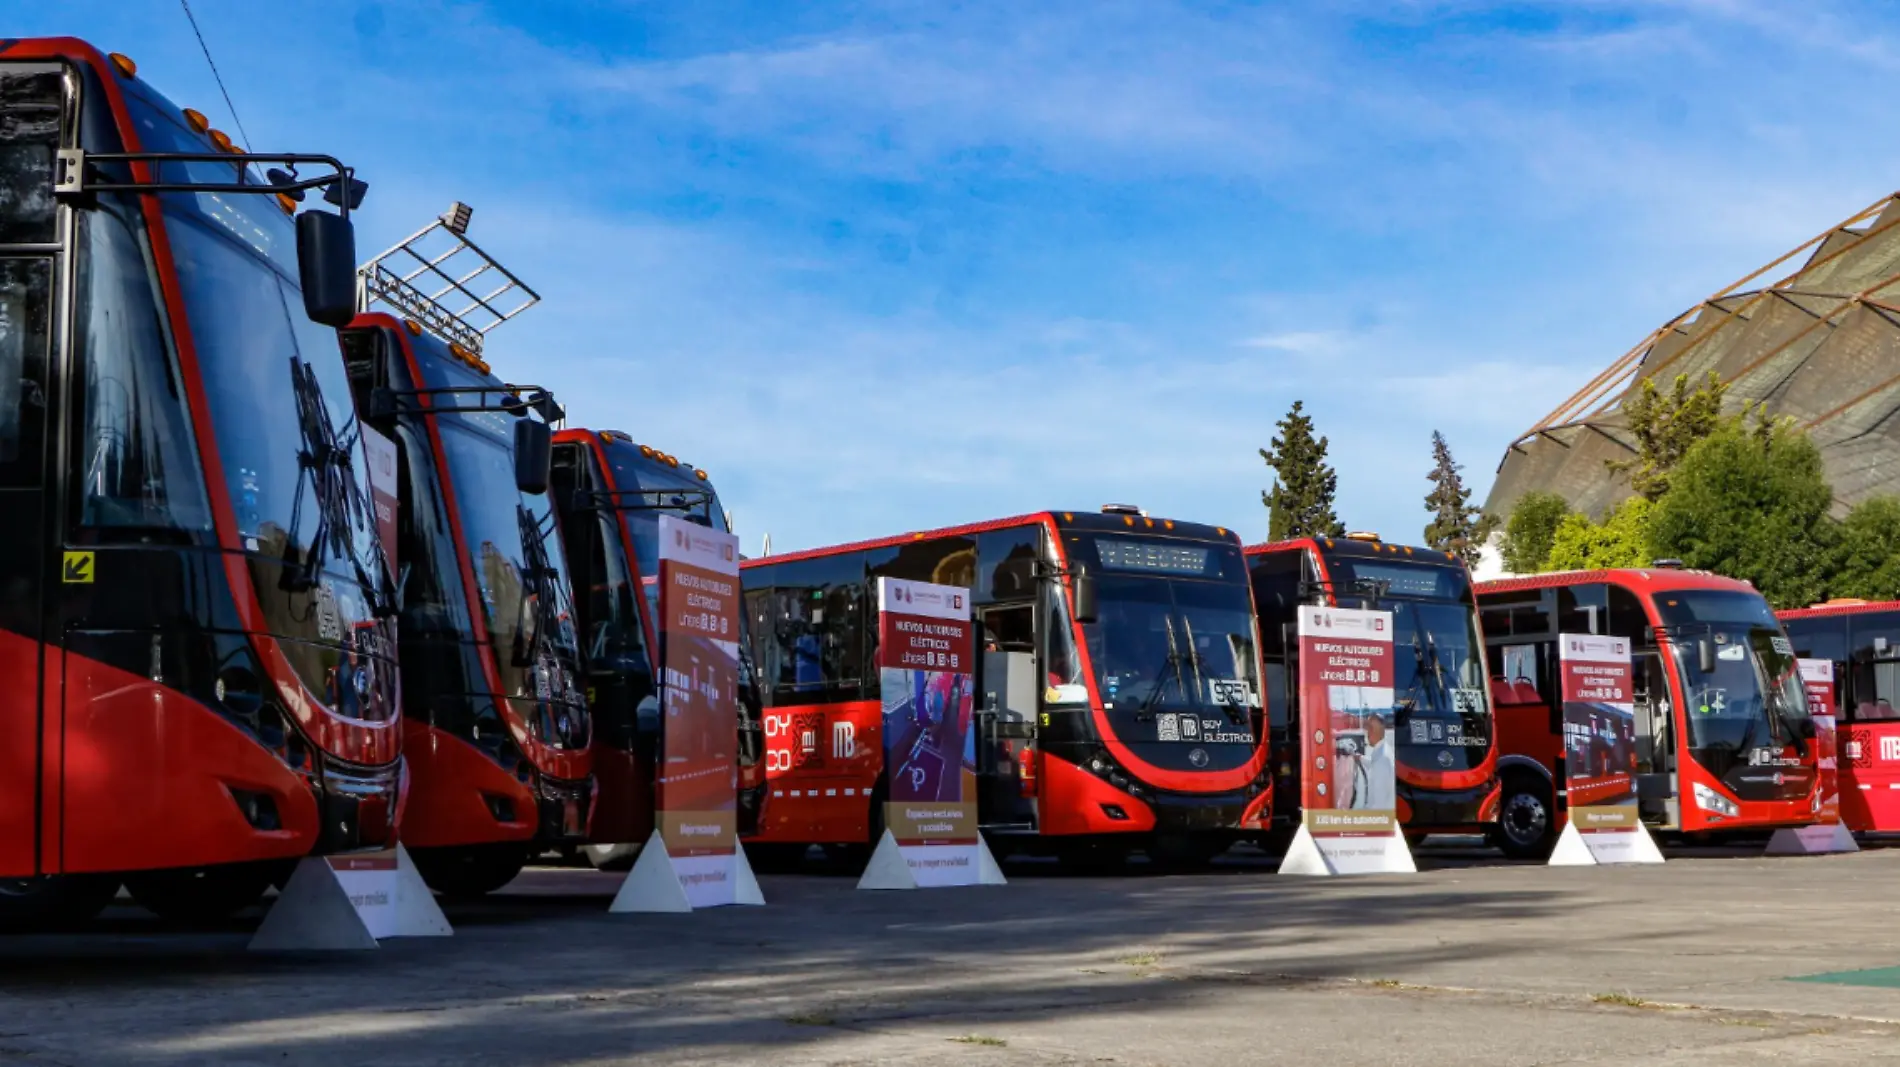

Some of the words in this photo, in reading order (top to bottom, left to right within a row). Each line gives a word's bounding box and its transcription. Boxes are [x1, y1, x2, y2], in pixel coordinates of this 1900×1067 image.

[895, 620, 923, 633] NUEVOS
[924, 624, 963, 638] AUTOBUSES
[910, 635, 950, 650] ELÉCTRICOS
[1314, 643, 1343, 653] NUEVOS
[1344, 645, 1384, 656] AUTOBUSES
[1328, 656, 1371, 667] ELÉCTRICOS
